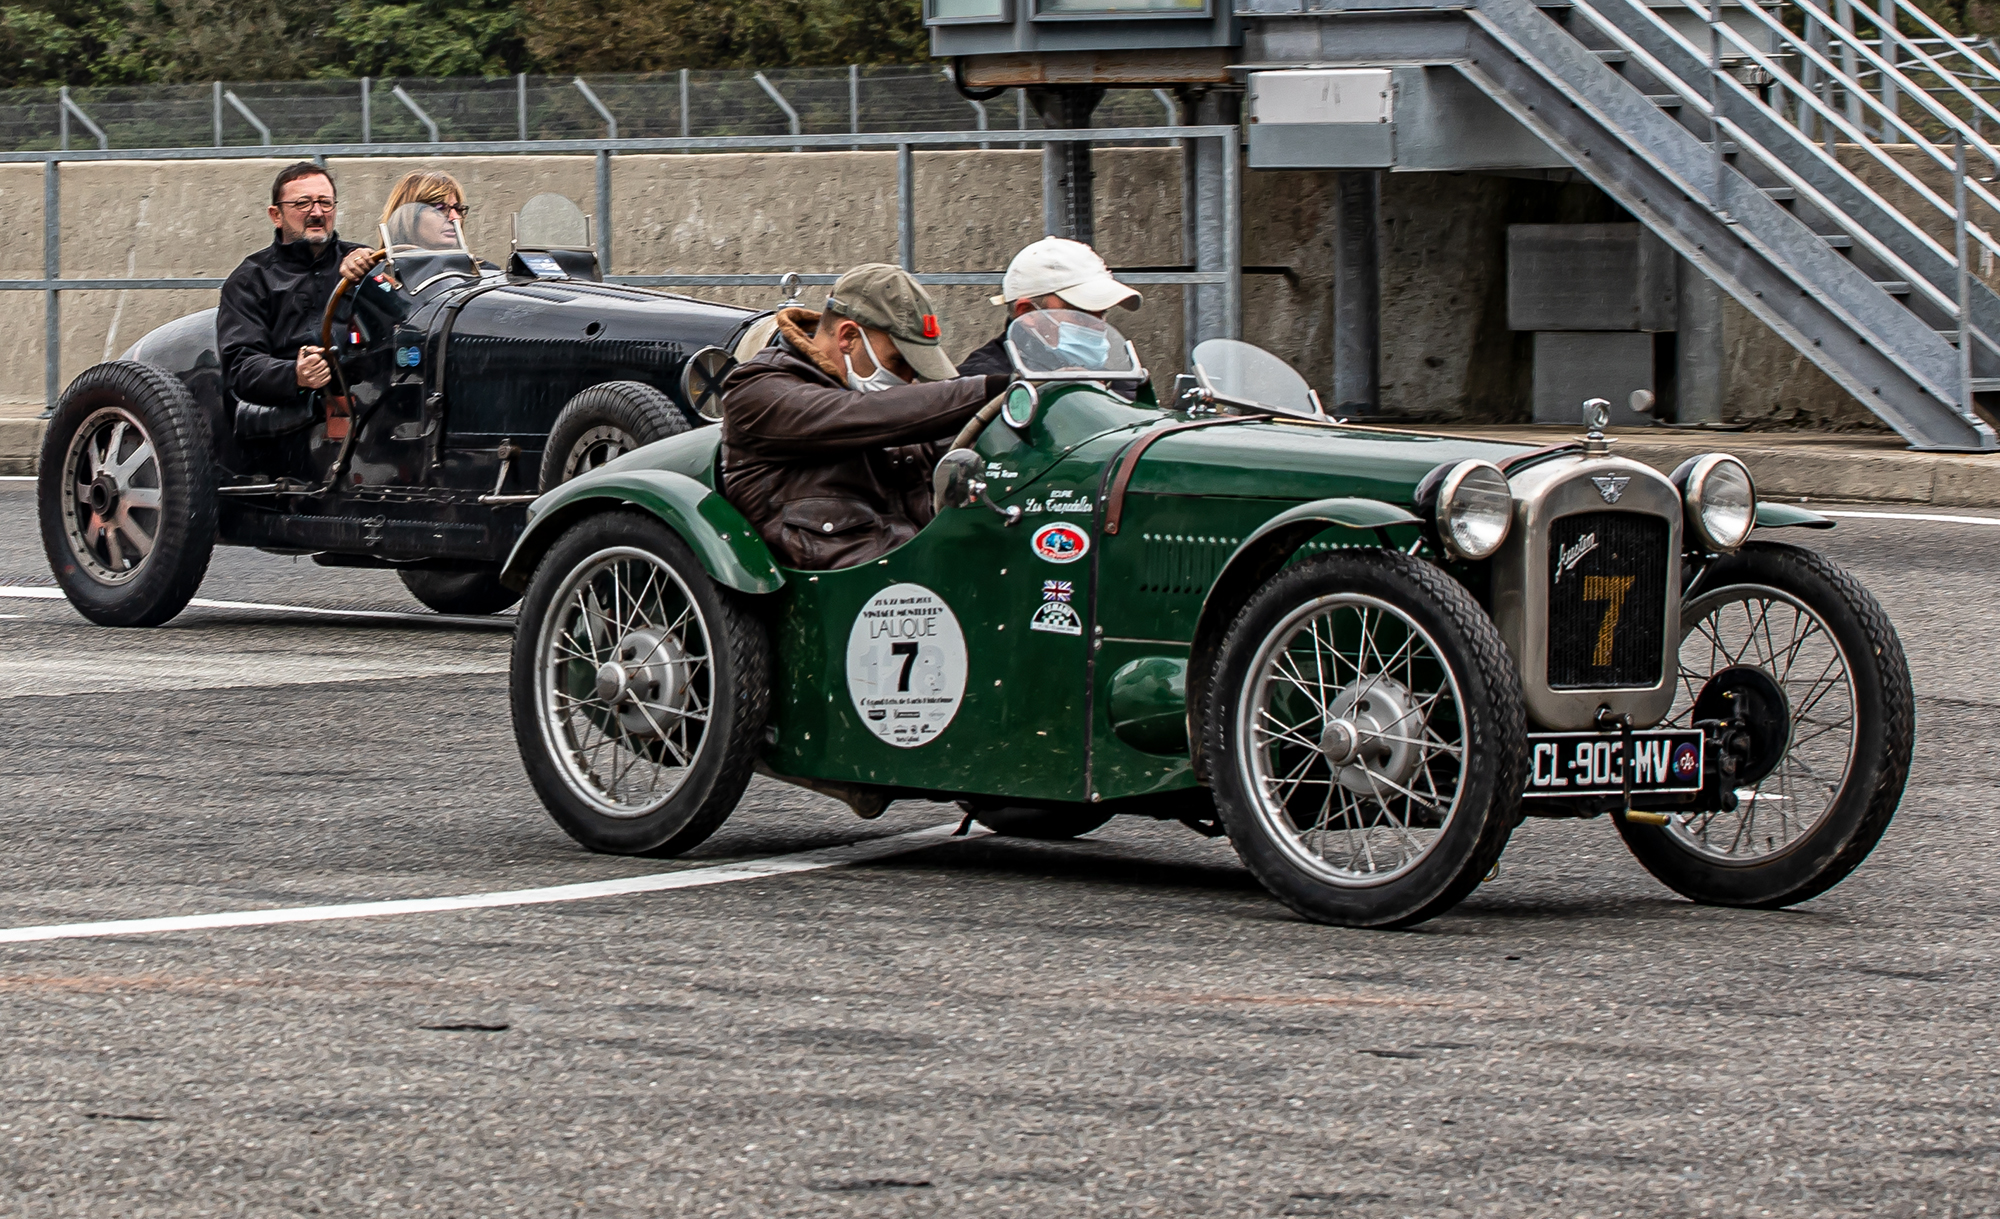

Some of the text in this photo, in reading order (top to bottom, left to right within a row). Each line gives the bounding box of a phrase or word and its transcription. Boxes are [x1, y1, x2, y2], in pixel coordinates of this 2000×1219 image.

[869, 617, 938, 639] LALIQUE
[1583, 575, 1635, 666] 7
[891, 641, 919, 692] 7
[1533, 740, 1671, 787] CL-903-MV
